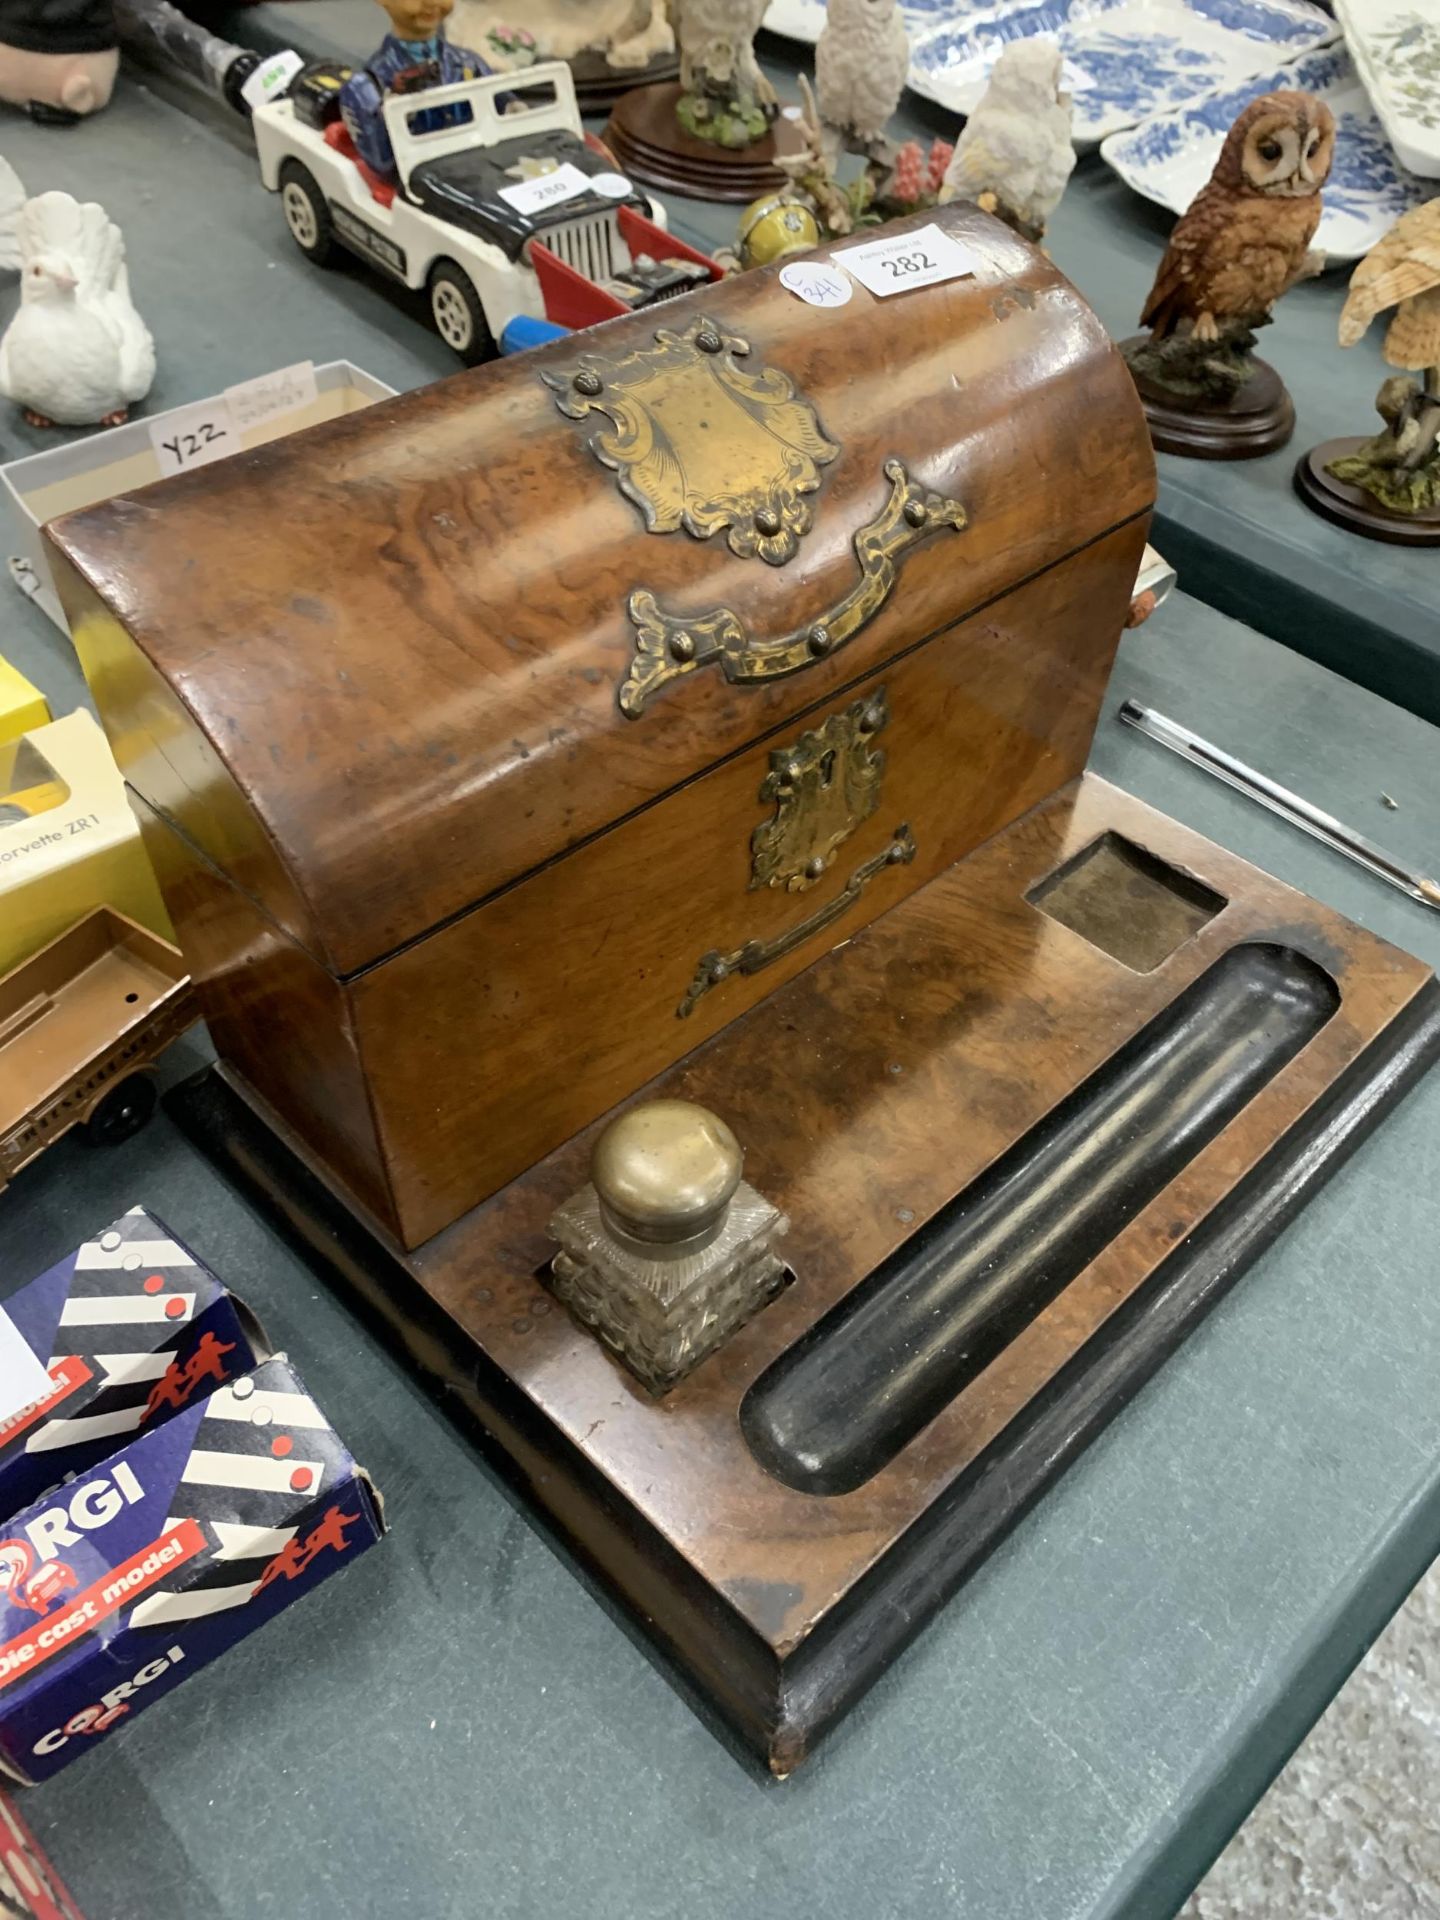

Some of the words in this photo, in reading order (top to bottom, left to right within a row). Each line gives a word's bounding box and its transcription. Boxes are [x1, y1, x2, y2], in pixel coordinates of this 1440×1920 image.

[881, 252, 937, 277] 282
[162, 423, 226, 465] Y22
[0, 832, 63, 865] orvette
[101, 1537, 184, 1604] model
[32, 1644, 186, 1756] CORGI
